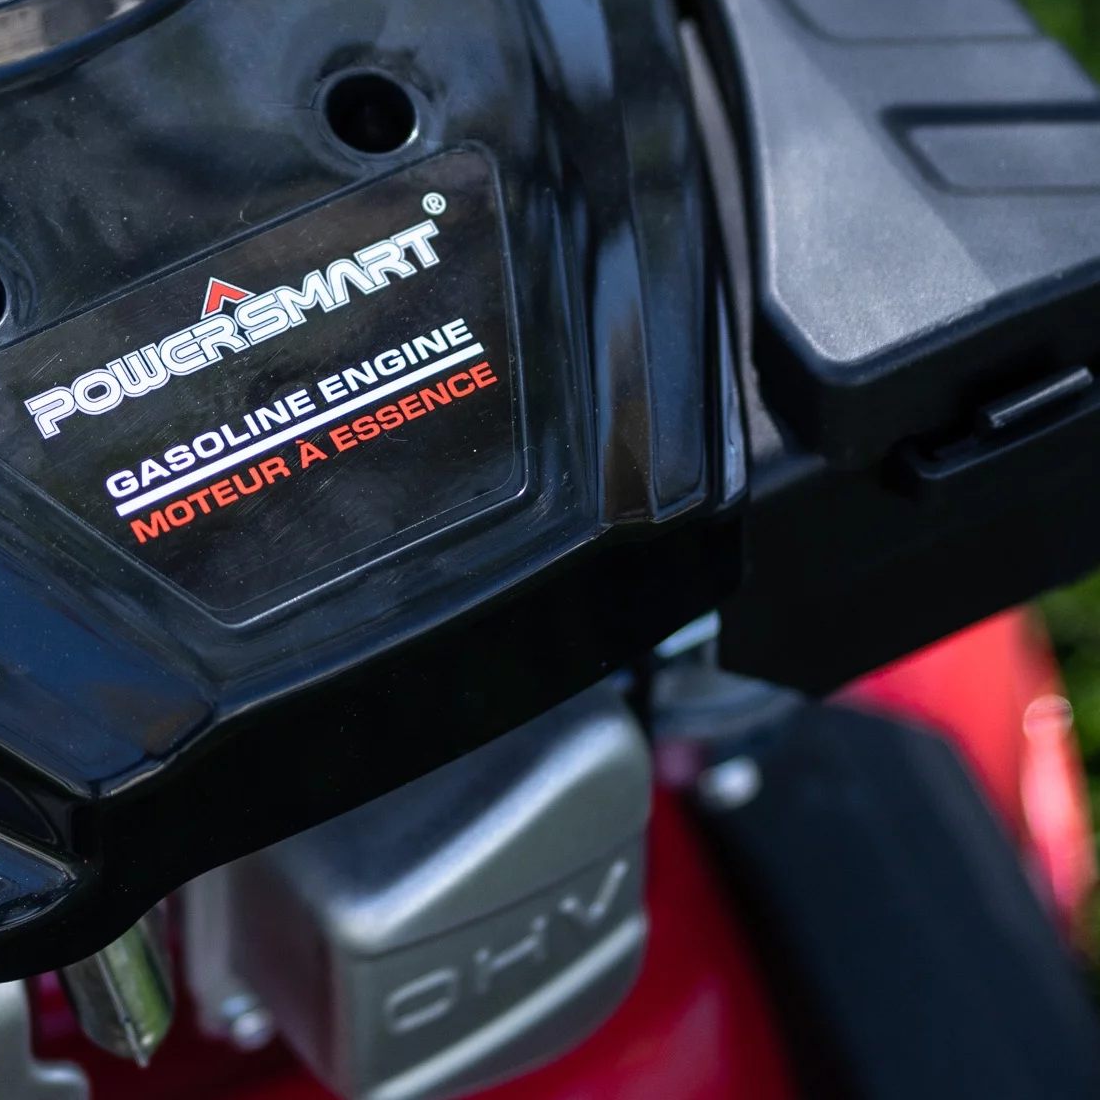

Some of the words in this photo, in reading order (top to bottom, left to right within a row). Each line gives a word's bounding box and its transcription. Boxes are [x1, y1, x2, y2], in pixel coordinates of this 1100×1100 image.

[105, 389, 316, 499] GASOLINE
[316, 318, 474, 403] ENGINE
[129, 456, 292, 544] MOTEUR
[297, 438, 328, 469] À
[328, 362, 499, 453] ESSENCE
[385, 860, 629, 1033] OHV
